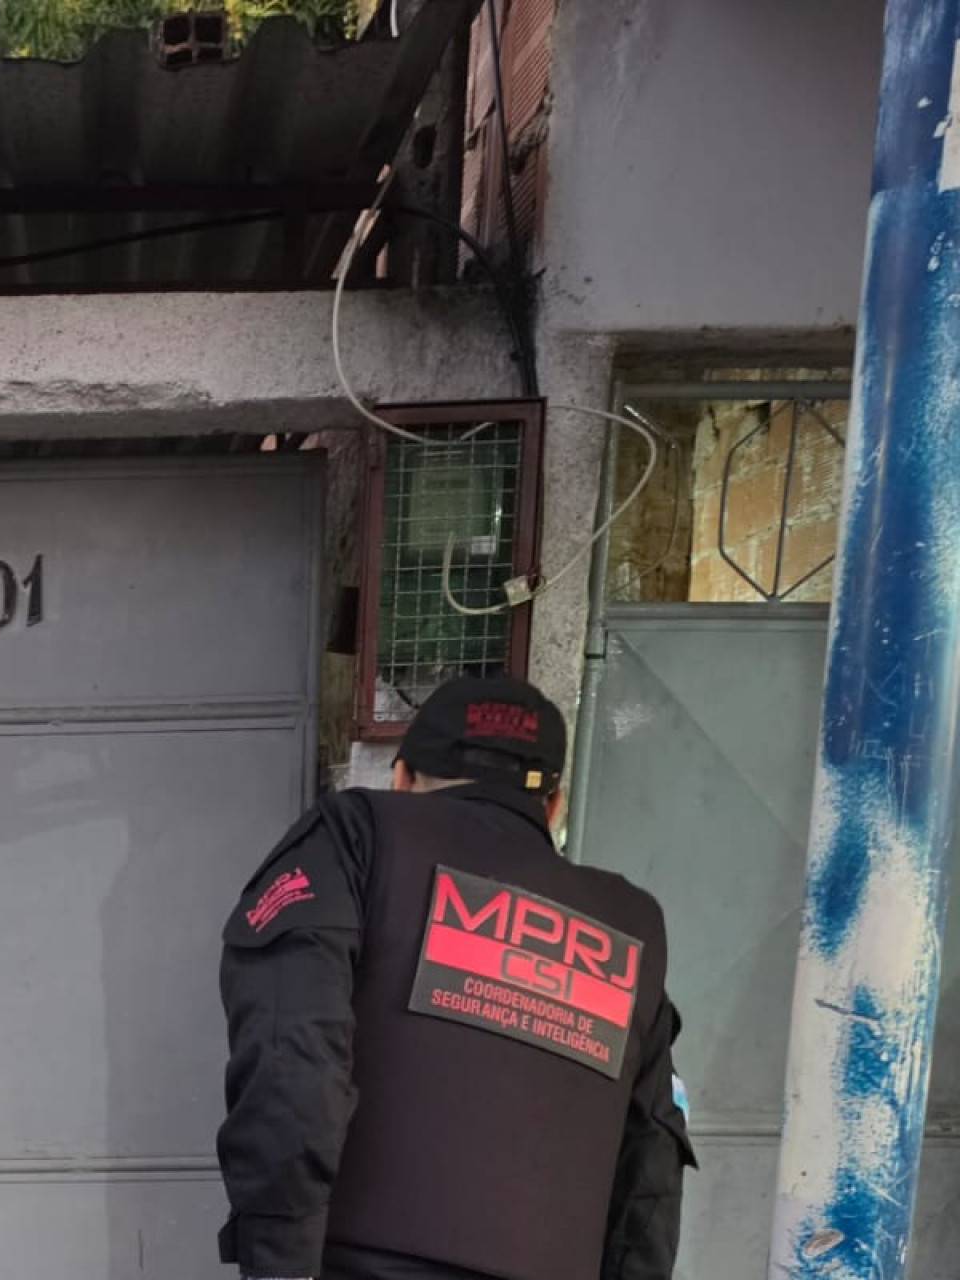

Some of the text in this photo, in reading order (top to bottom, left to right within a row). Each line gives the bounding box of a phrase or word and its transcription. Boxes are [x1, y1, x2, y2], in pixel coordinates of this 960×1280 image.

[433, 873, 638, 989] MPRJ
[501, 948, 574, 1001] CSI
[431, 988, 518, 1028] SEGURANÇA
[521, 1015, 529, 1031] E
[463, 977, 593, 1034] COORDENADORIA DE
